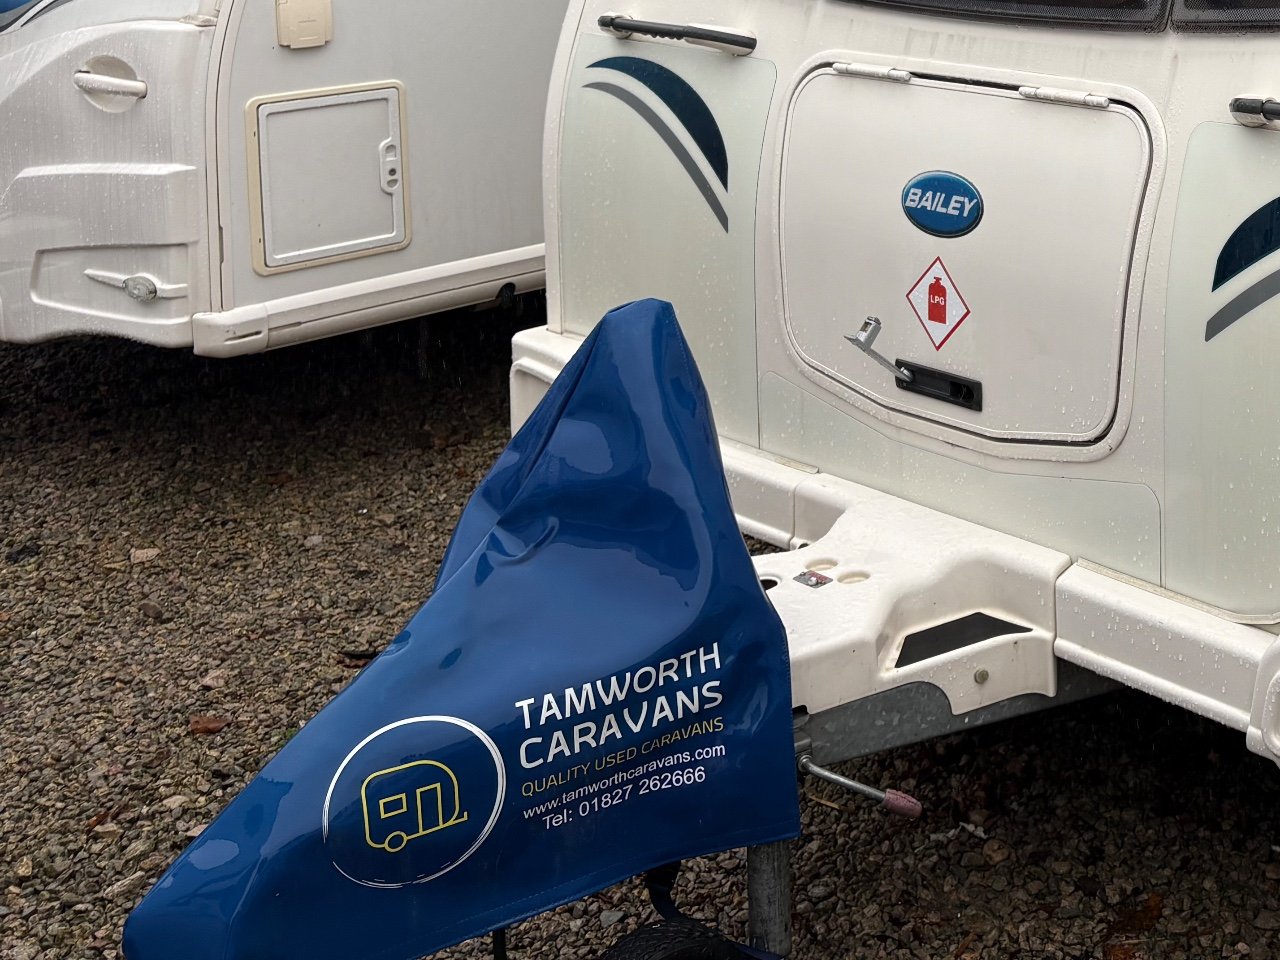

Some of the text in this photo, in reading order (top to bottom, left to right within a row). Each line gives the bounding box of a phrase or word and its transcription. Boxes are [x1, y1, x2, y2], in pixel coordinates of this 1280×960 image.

[905, 188, 977, 217] BAILEY
[930, 294, 945, 305] LPG
[515, 642, 721, 729] TAMWORTH
[519, 680, 723, 769] CARAVANS
[521, 716, 724, 797] QUALITY USED CARAVANS
[523, 744, 726, 819] www.tamworthcaravans.com
[542, 766, 706, 830] Tel: 01827 262666
